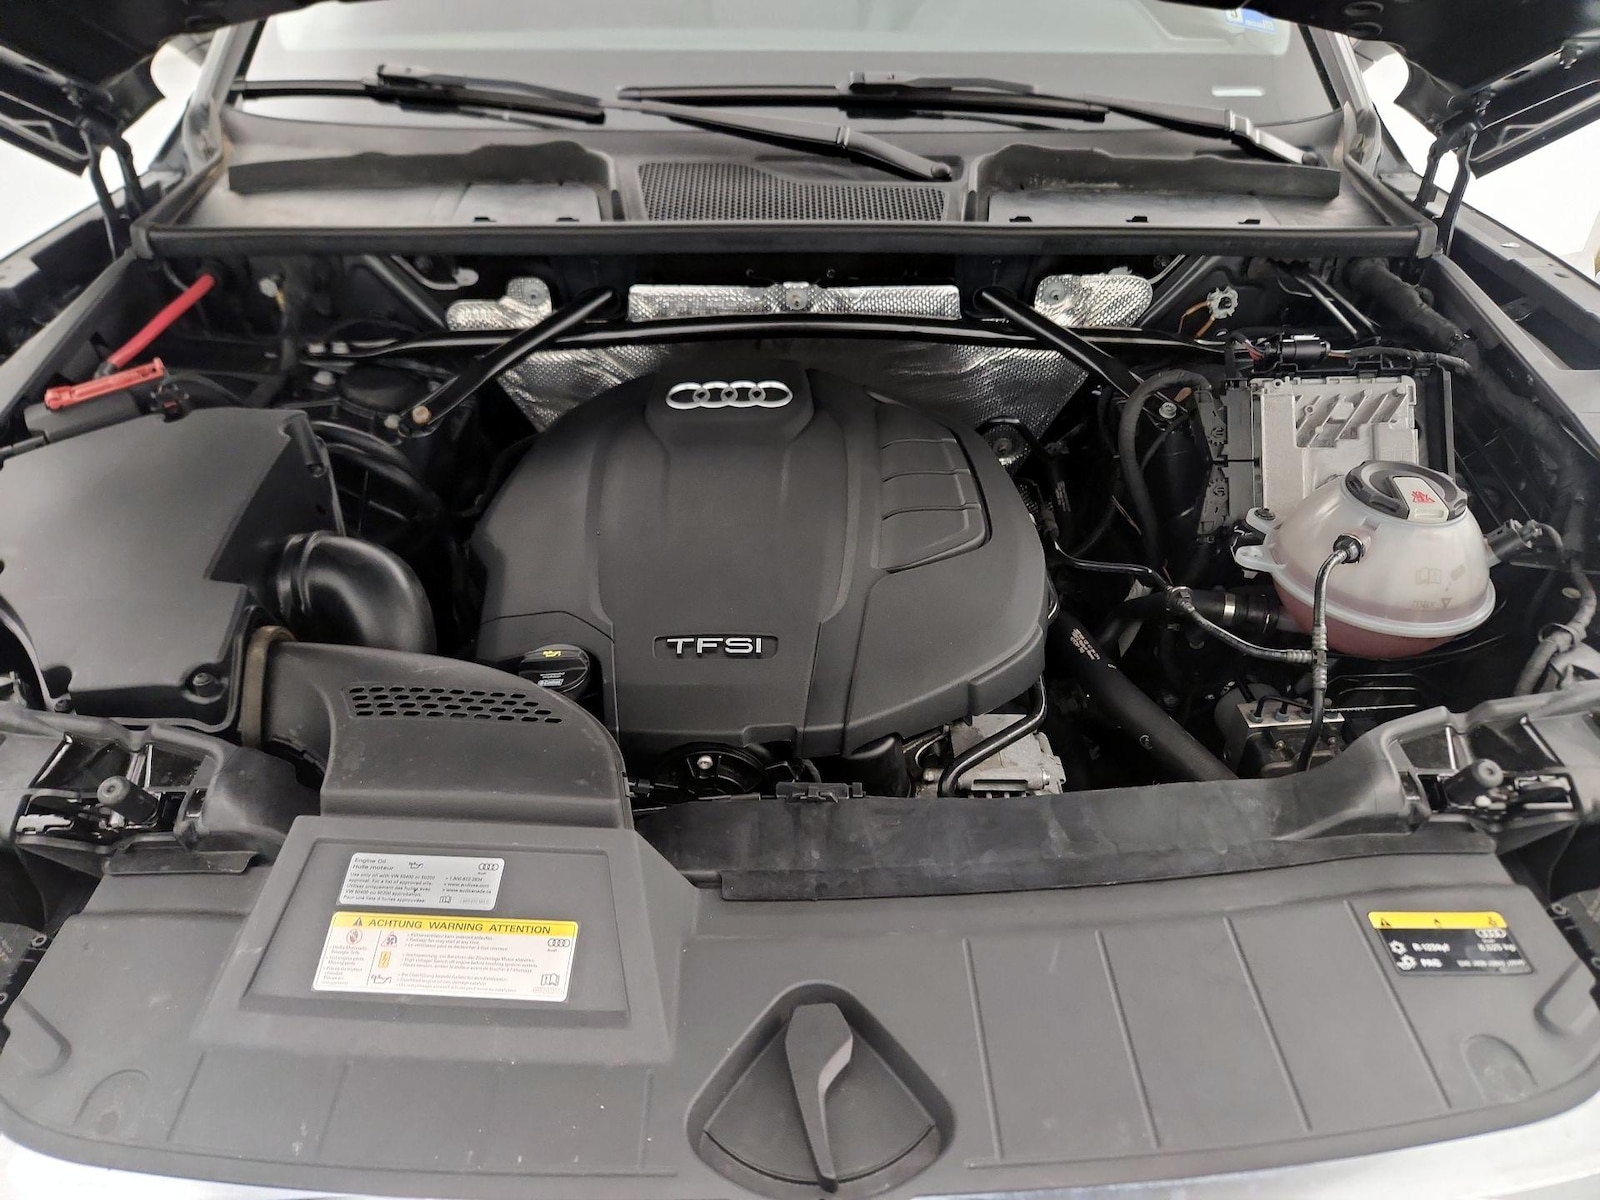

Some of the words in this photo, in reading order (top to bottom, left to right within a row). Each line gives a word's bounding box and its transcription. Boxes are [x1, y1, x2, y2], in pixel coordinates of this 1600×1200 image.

[666, 637, 762, 655] TFSI
[368, 920, 423, 929] ACHTUNG
[429, 922, 483, 931] WARNING
[489, 925, 551, 934] ATTENTION
